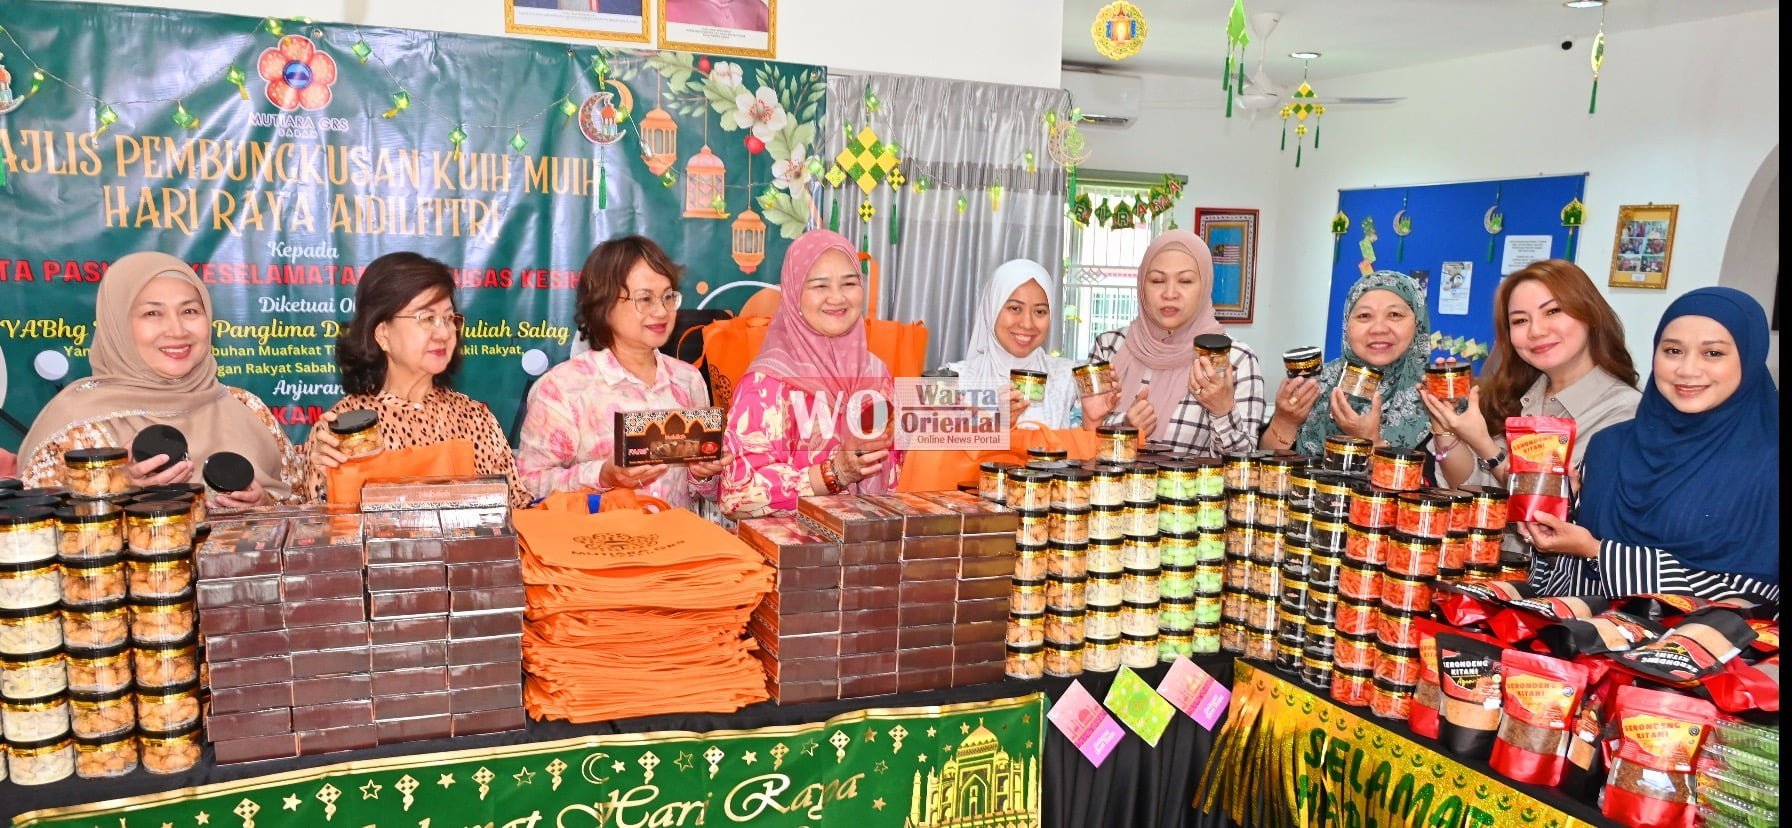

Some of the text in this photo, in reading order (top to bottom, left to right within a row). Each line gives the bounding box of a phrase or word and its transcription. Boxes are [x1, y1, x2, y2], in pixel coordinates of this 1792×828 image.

[319, 117, 348, 132] GRS
[434, 151, 510, 193] KUIH
[104, 185, 500, 243] HARI RAYA AIDILFITRI
[267, 241, 339, 264] Kepada
[43, 261, 109, 283] PAS
[190, 263, 366, 286] ESELAMATA
[449, 268, 513, 288] UGAS
[258, 295, 336, 313] Diketuai
[212, 319, 317, 345] Panglima
[461, 320, 512, 338] uliah
[517, 320, 570, 345] Salag
[211, 345, 255, 356] buhan
[259, 345, 320, 356] Muafakat
[217, 365, 241, 376] gan
[246, 363, 291, 376] Rakyat
[295, 362, 336, 373] Sabah
[1450, 668, 1479, 676] KITANI
[1303, 727, 1496, 828] SELAMAT
[556, 773, 865, 828] Hari Raya
